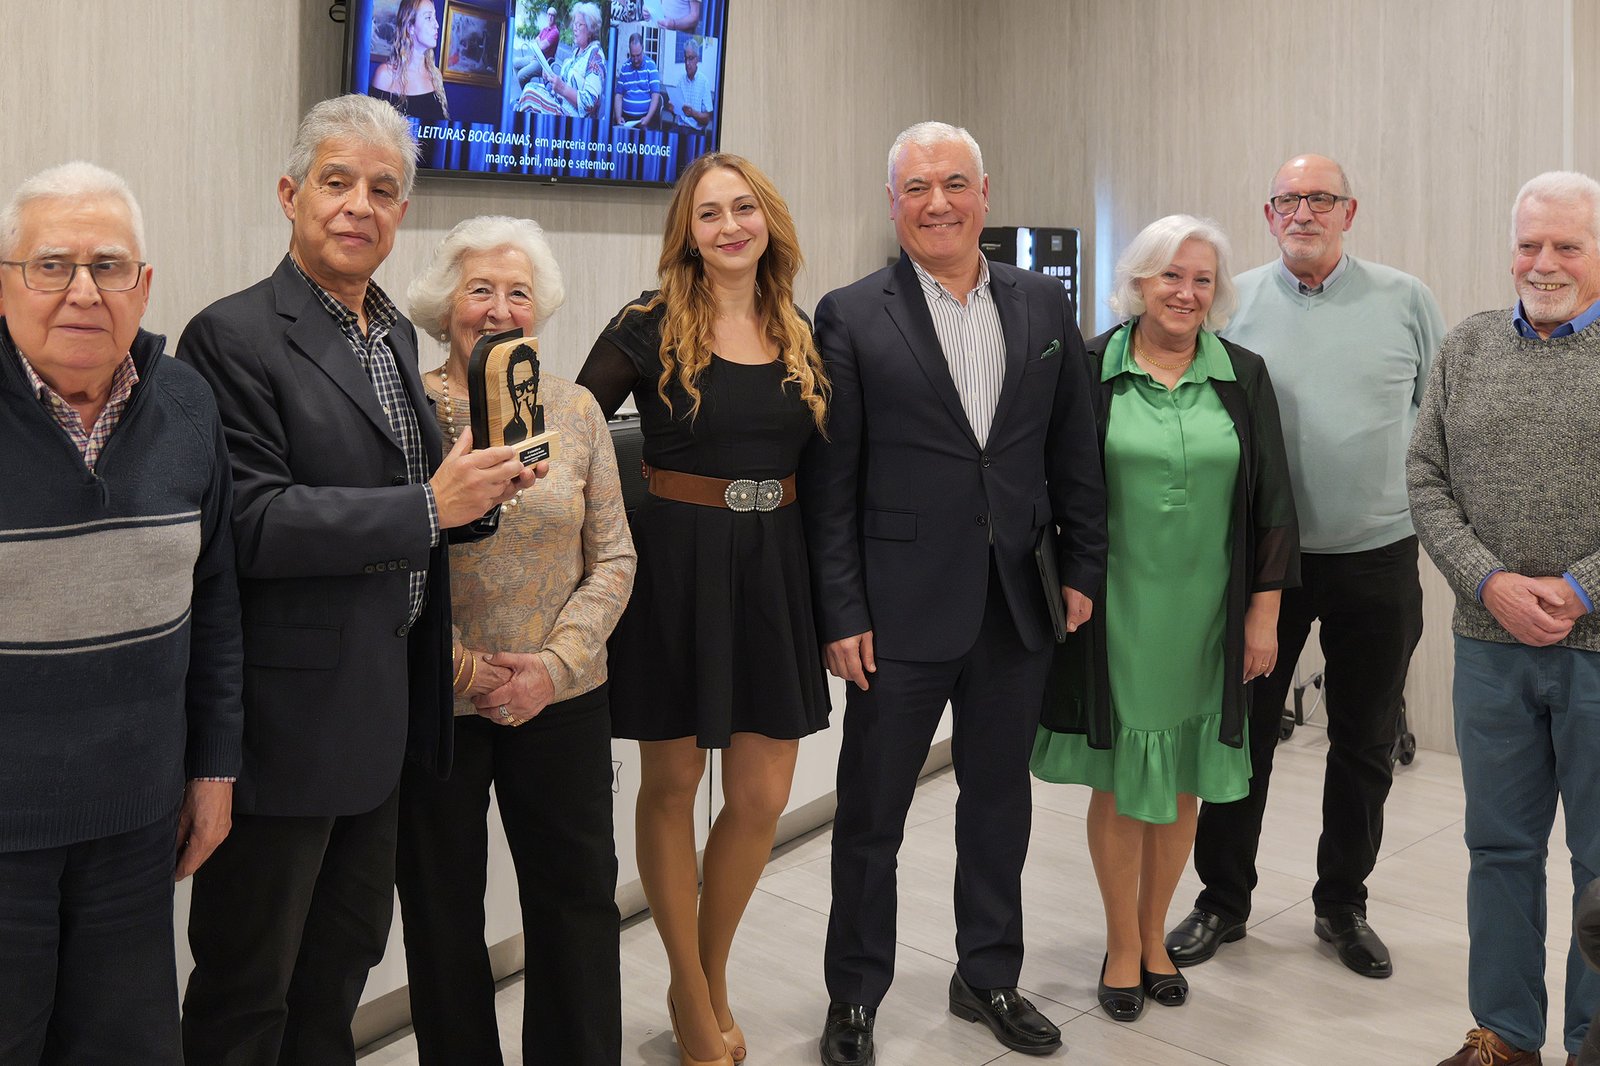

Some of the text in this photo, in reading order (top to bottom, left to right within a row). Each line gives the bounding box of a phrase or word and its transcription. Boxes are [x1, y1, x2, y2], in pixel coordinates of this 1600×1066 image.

[417, 125, 671, 157] LEITURAS BOCAGIANAS, em parceria com a CASA BOCAGE
[485, 153, 615, 171] março, abril, maio e setembro
